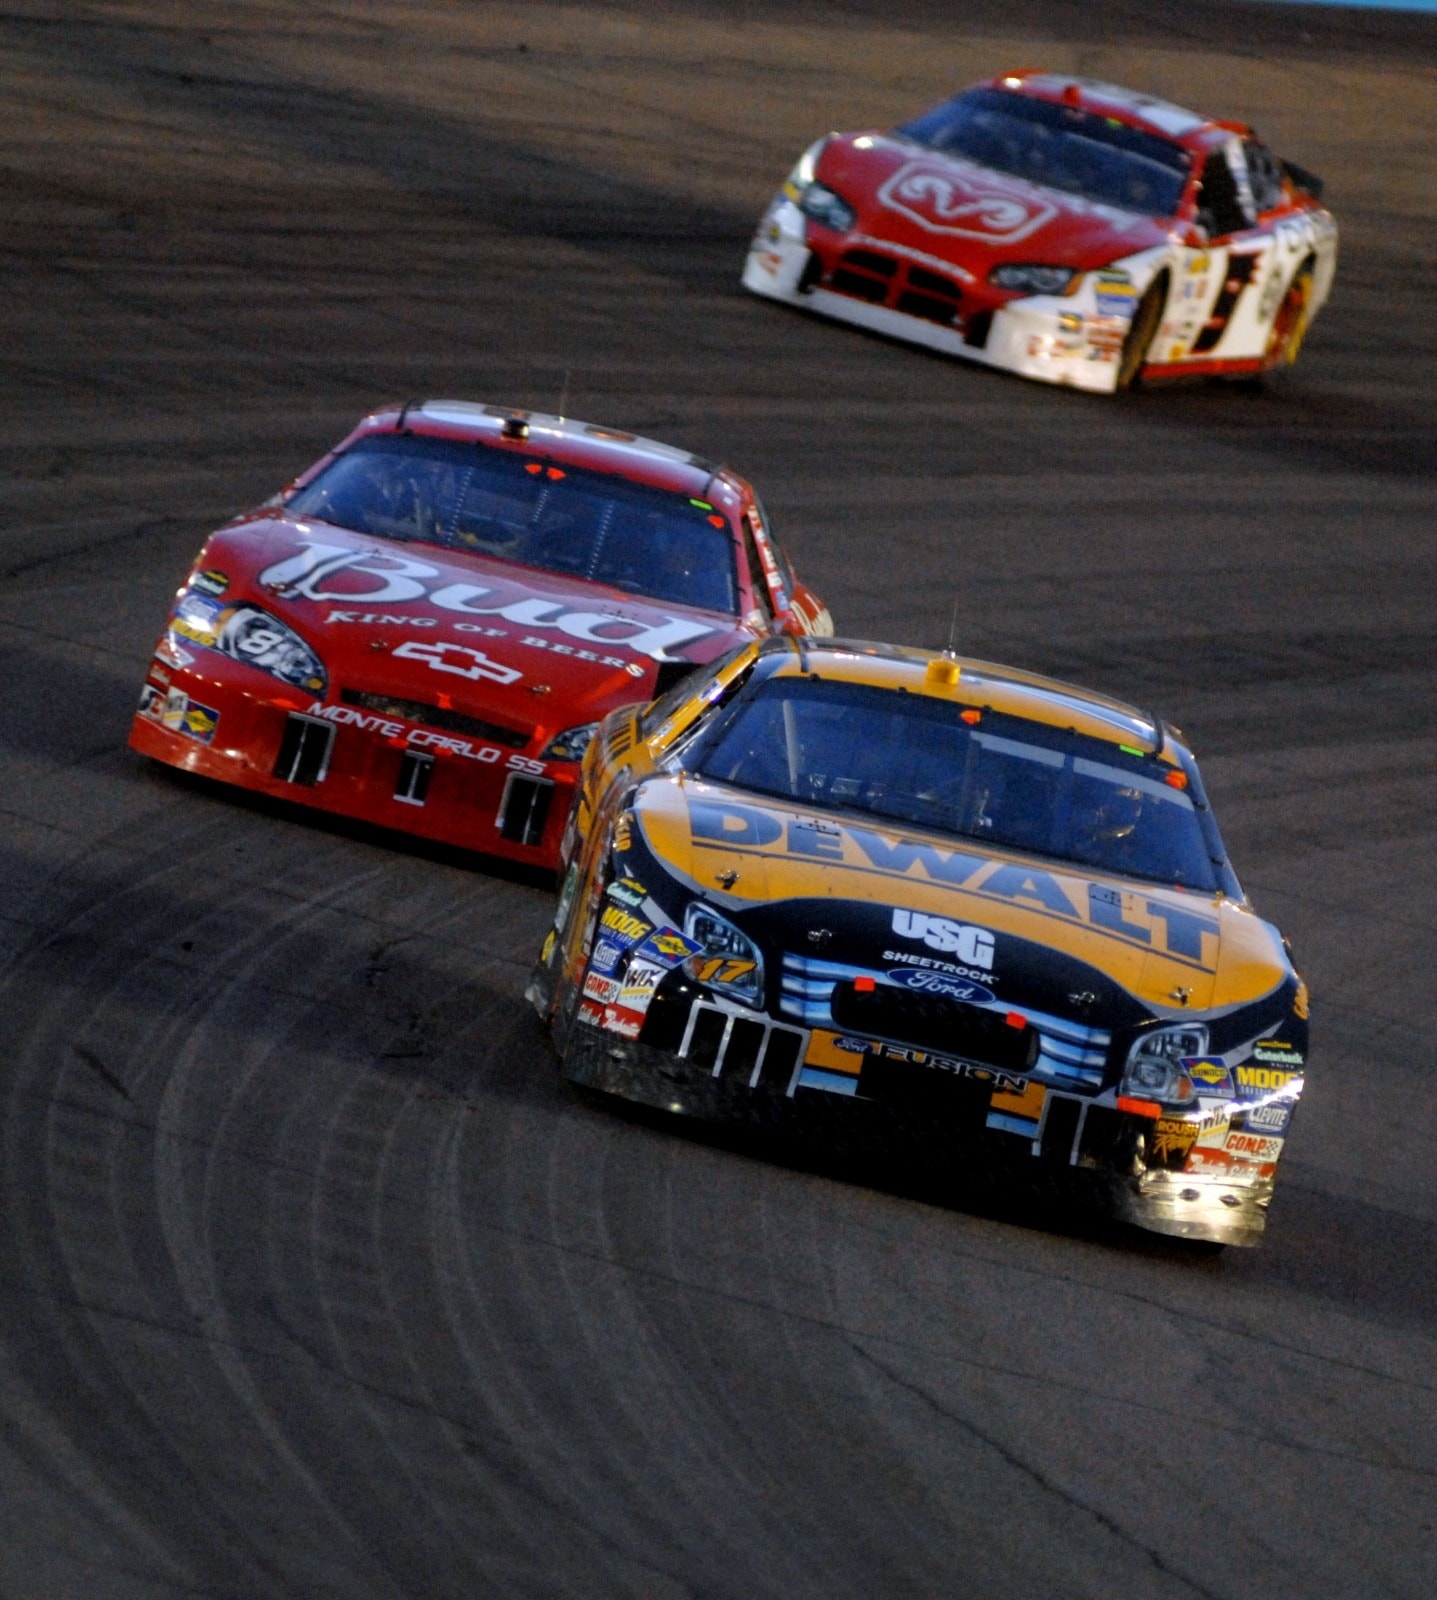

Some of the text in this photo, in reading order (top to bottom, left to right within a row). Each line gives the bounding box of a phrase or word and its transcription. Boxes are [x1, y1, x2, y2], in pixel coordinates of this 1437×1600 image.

[257, 542, 715, 663] Bud
[238, 629, 284, 655] 8
[325, 610, 646, 678] KING OF BEERS
[304, 702, 548, 775] MONTE CARLO SS
[690, 803, 1220, 961] DEWALT
[600, 906, 652, 940] MOOG
[891, 908, 996, 970] USG
[697, 958, 757, 983] 17
[882, 950, 997, 985] SHEETROCK
[907, 970, 977, 1001] Ford
[836, 1036, 866, 1053] Ford
[879, 1042, 1029, 1093] FUSION
[1190, 1068, 1228, 1078] SUNOCO
[1157, 1120, 1200, 1136] ROUSH
[1226, 1135, 1268, 1153] COMP
